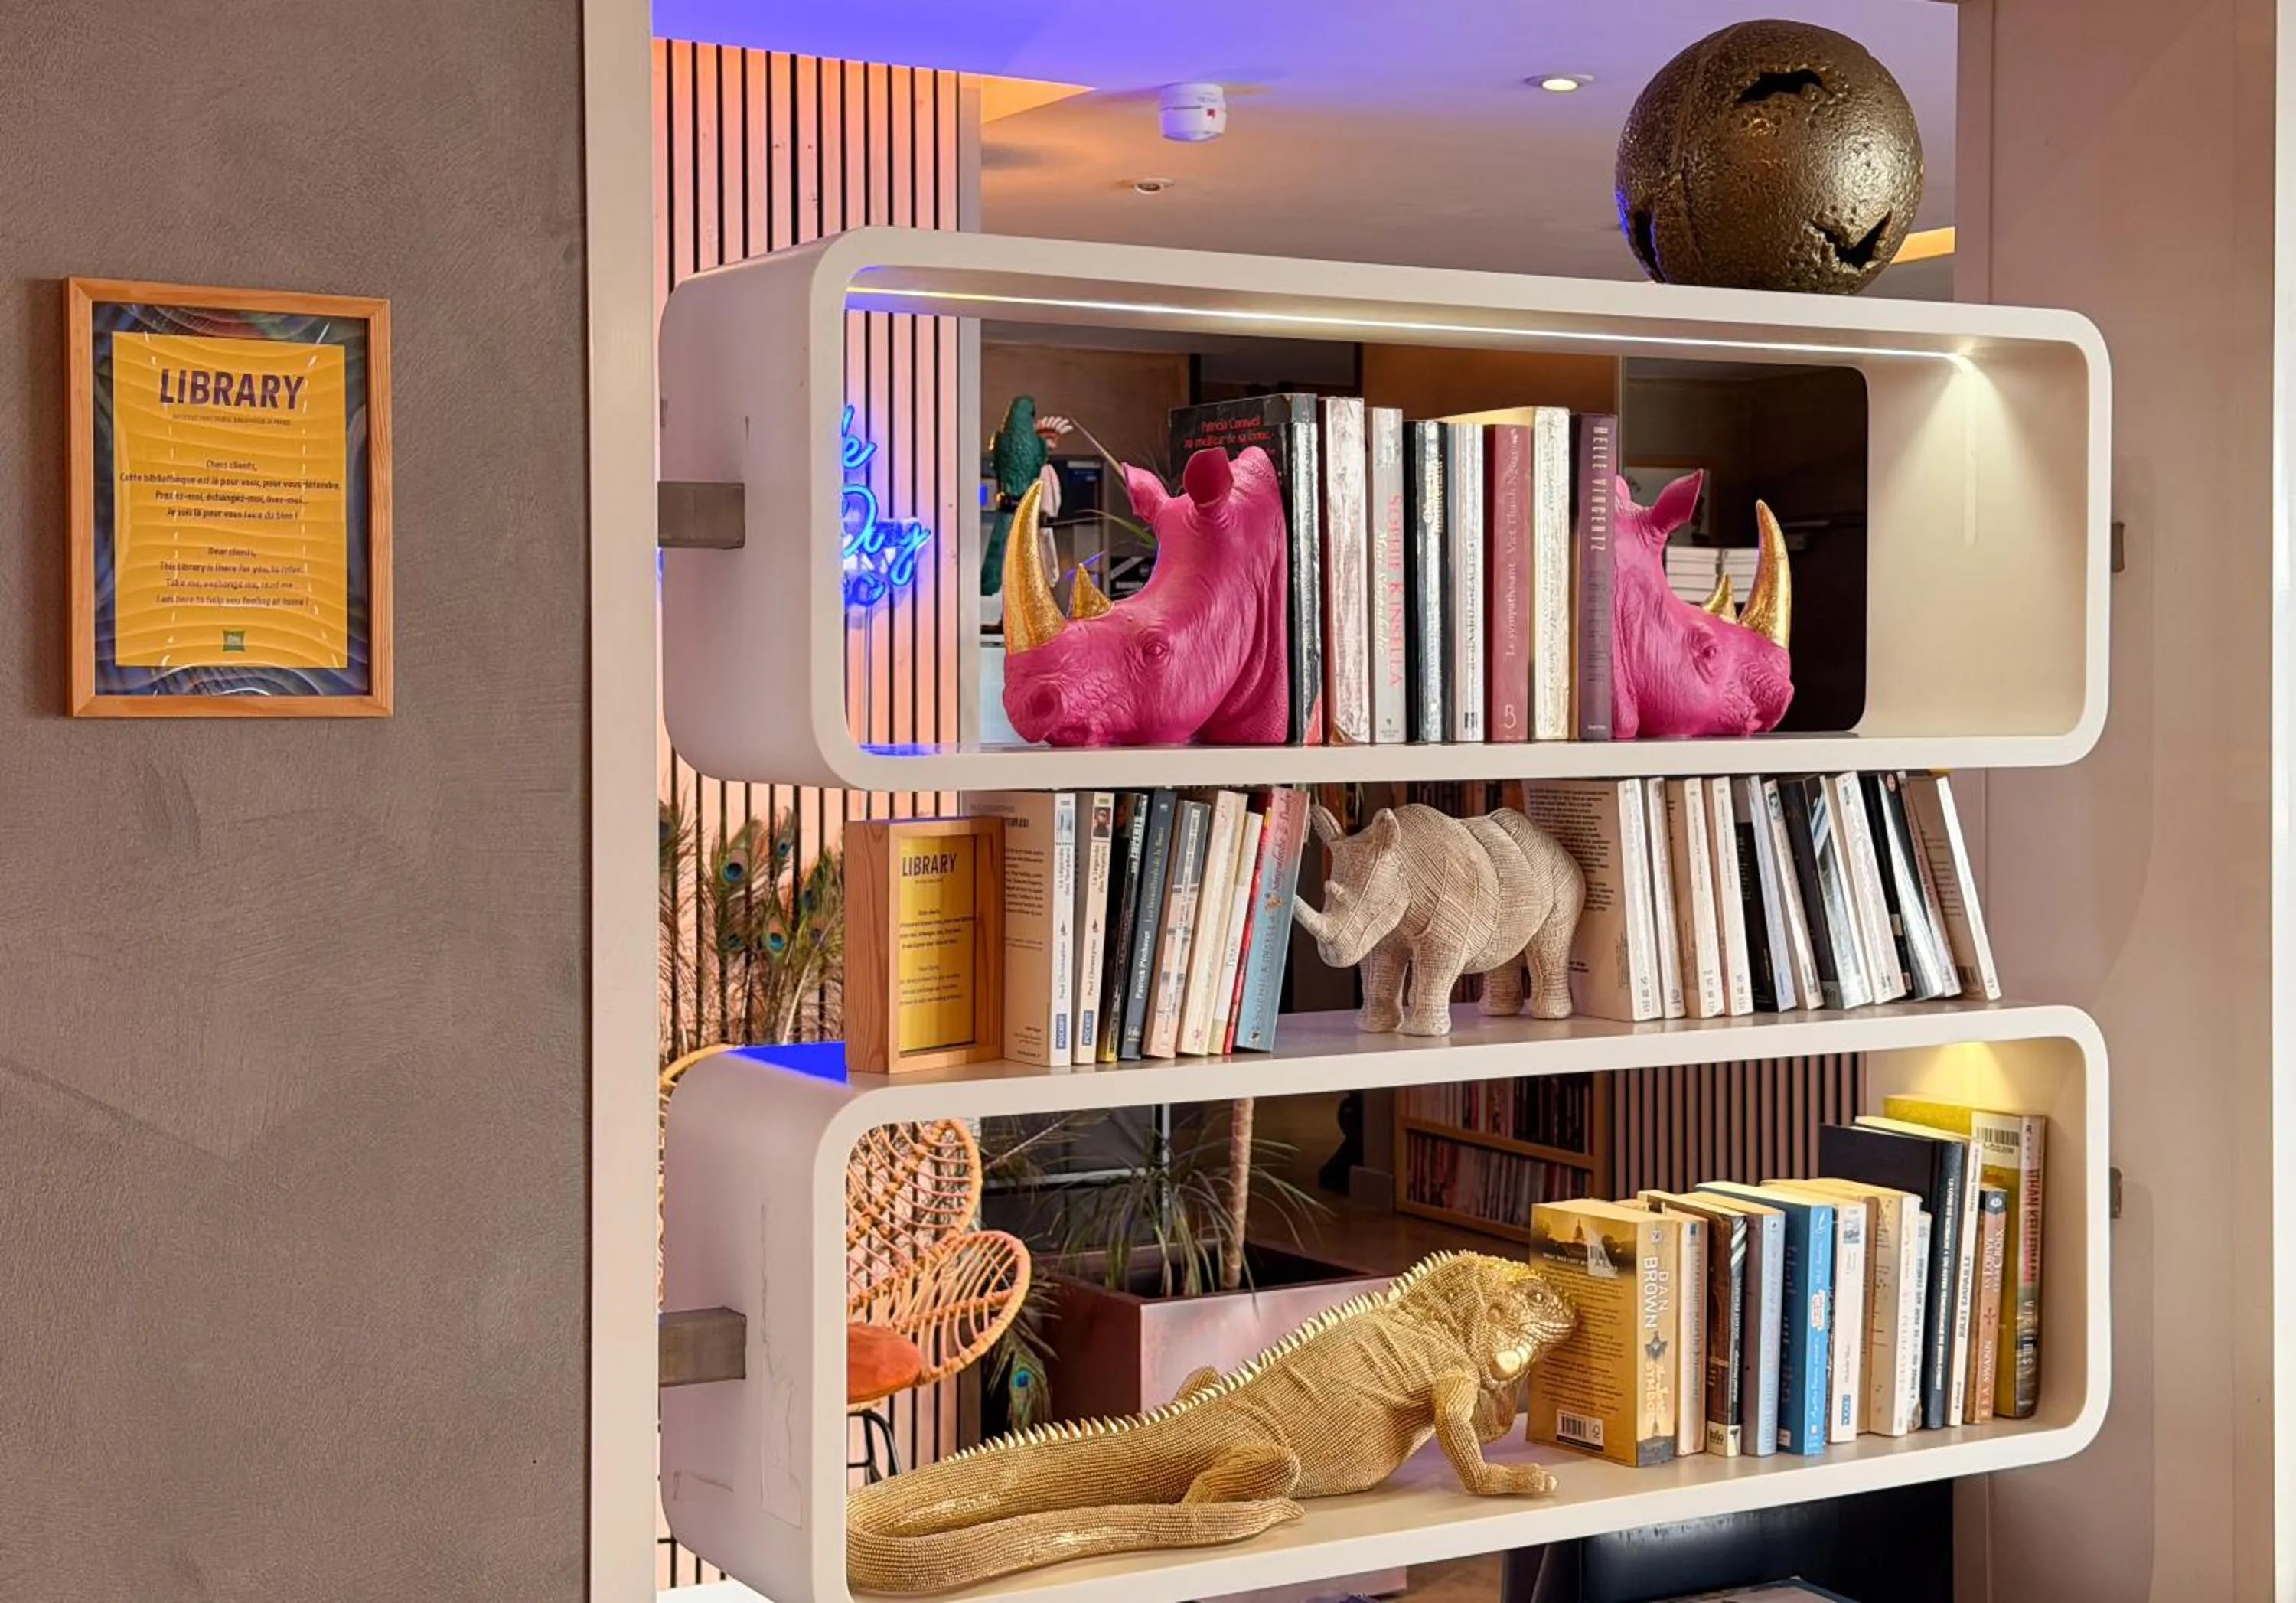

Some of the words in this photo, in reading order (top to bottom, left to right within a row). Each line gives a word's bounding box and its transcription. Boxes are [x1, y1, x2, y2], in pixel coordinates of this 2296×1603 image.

[159, 368, 305, 410] LIBRARY
[1592, 426, 1609, 469] HELLE
[220, 478, 238, 488] pour
[263, 480, 281, 489] pour
[1388, 494, 1402, 570] SOPHIE
[1590, 478, 1607, 551] VINCENTZ
[1389, 582, 1404, 687] KINSELLA
[902, 852, 957, 877] LIBRARY
[1136, 969, 1146, 999] Patrick
[1057, 1014, 1067, 1049] POCKET
[1643, 1255, 1658, 1329] BROWN
[1657, 1270, 1670, 1312] DAN
